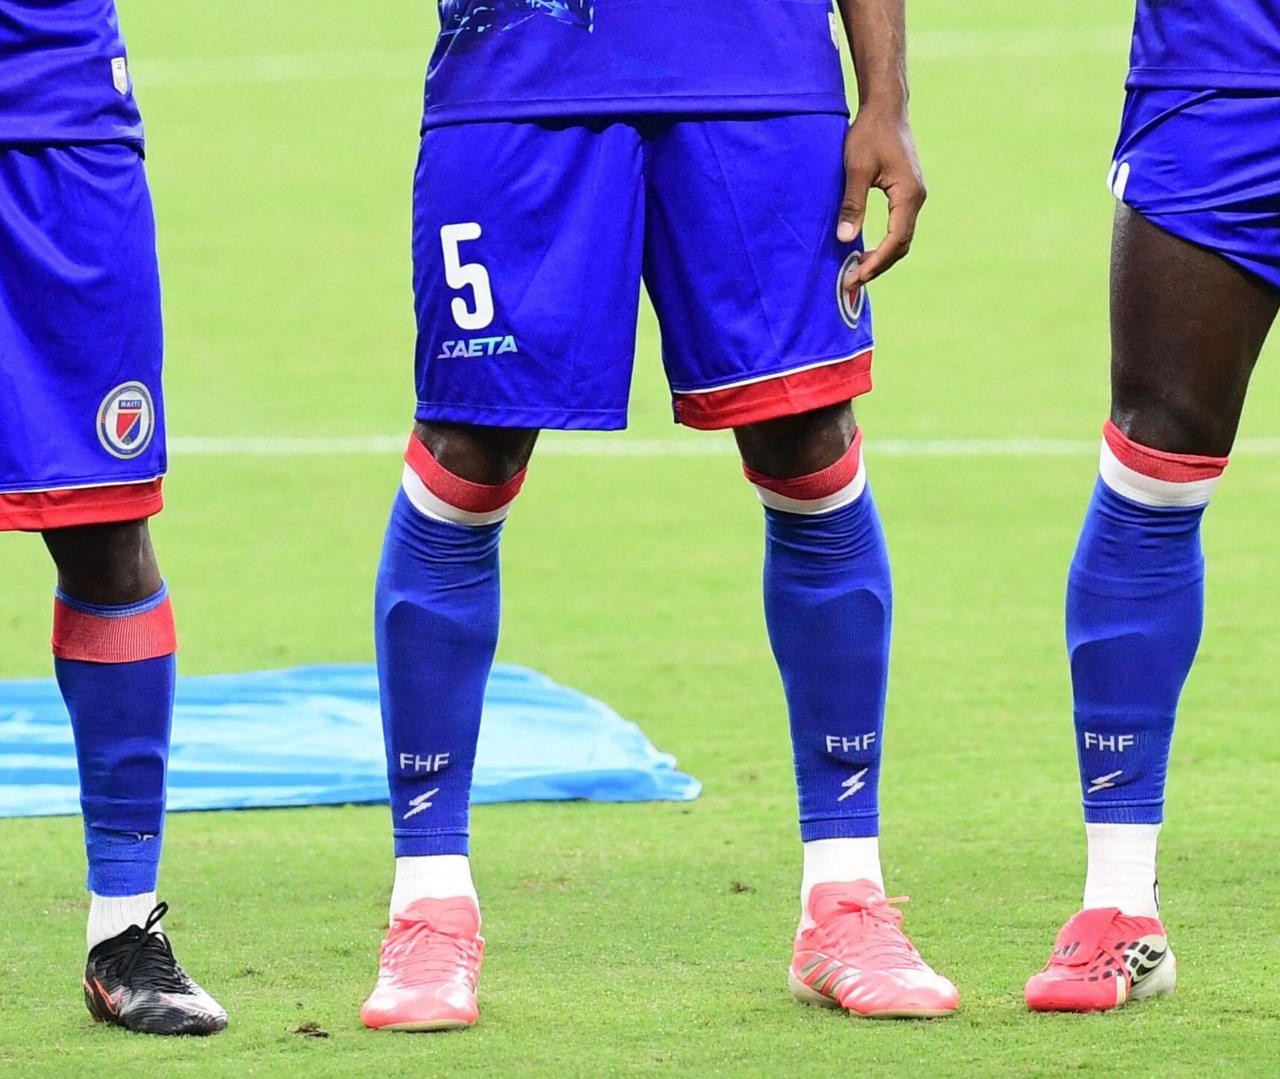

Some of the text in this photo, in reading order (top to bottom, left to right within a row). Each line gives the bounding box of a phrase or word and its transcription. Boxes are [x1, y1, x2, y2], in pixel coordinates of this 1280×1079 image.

[440, 222, 495, 330] 5
[437, 335, 518, 359] SAETA
[825, 731, 876, 753] FHF
[1084, 731, 1134, 752] FHF
[400, 752, 450, 772] FHF
